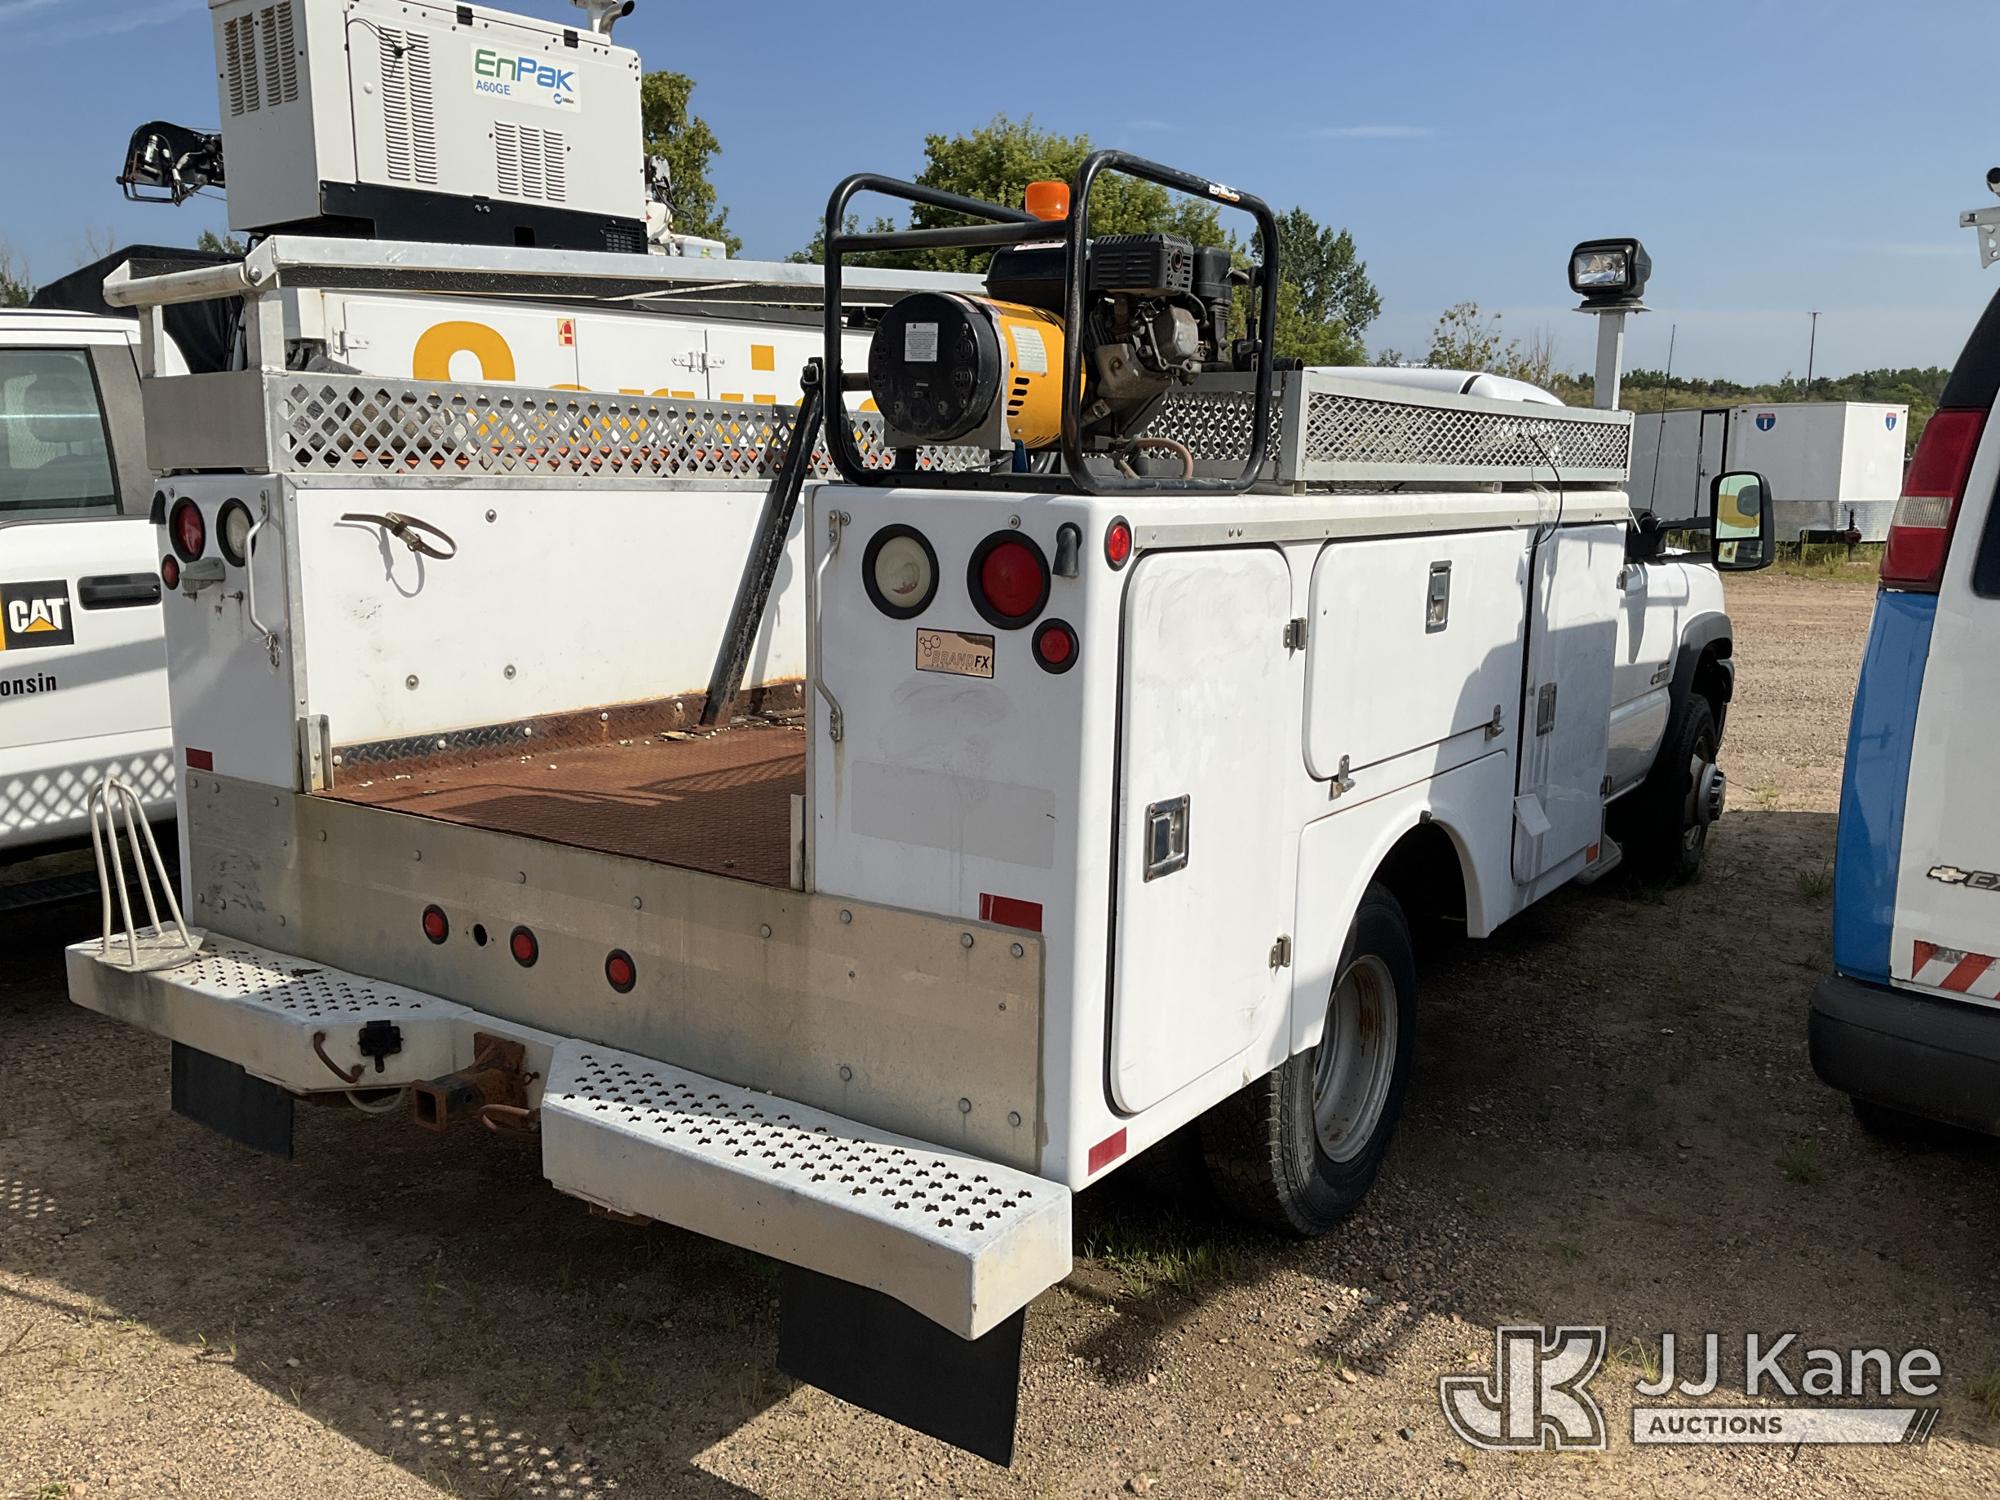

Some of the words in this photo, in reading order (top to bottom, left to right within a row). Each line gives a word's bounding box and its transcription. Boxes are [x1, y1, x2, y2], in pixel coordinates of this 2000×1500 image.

[475, 49, 575, 92] EnPak
[475, 80, 511, 95] A60GE
[8, 598, 65, 633] CAT
[0, 673, 57, 697] onsin
